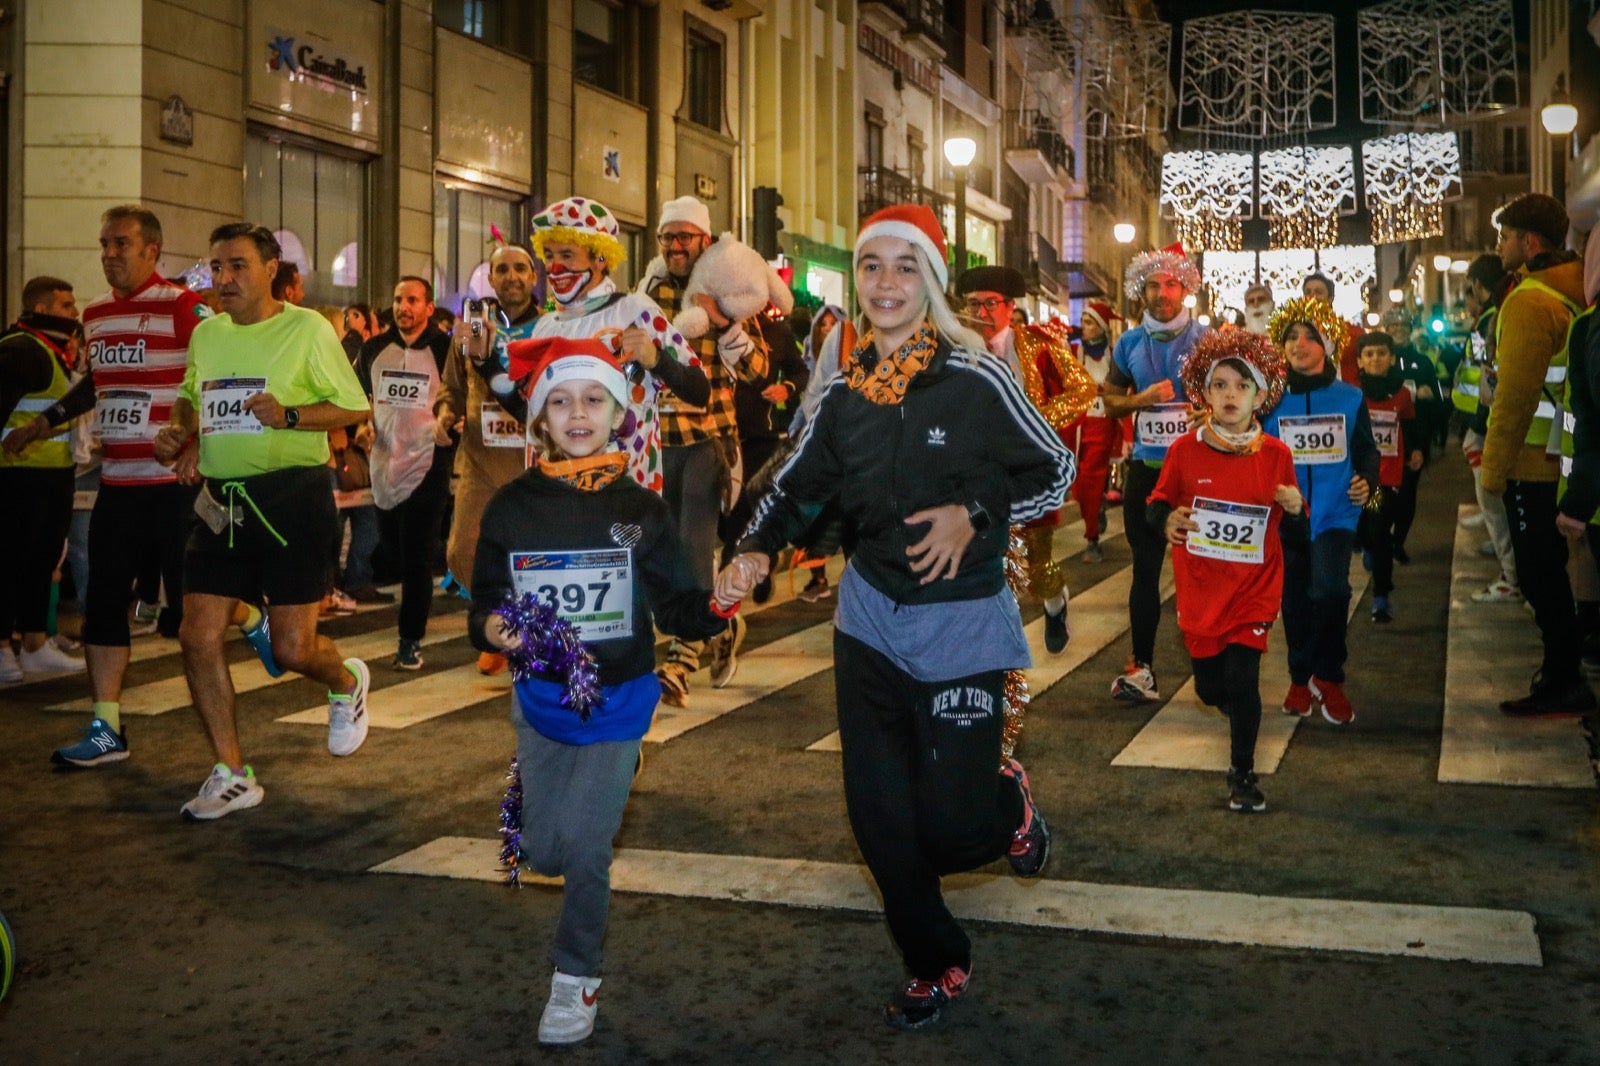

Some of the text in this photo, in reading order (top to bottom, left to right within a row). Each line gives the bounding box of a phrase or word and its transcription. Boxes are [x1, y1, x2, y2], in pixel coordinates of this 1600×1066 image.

[89, 340, 145, 365] Platzi
[388, 384, 419, 399] 602
[99, 408, 142, 425] 1165
[1145, 421, 1187, 435] 1308
[1294, 432, 1335, 449] 390
[1204, 520, 1254, 545] 392
[537, 582, 611, 613] 397
[932, 687, 994, 716] NEW YORK
